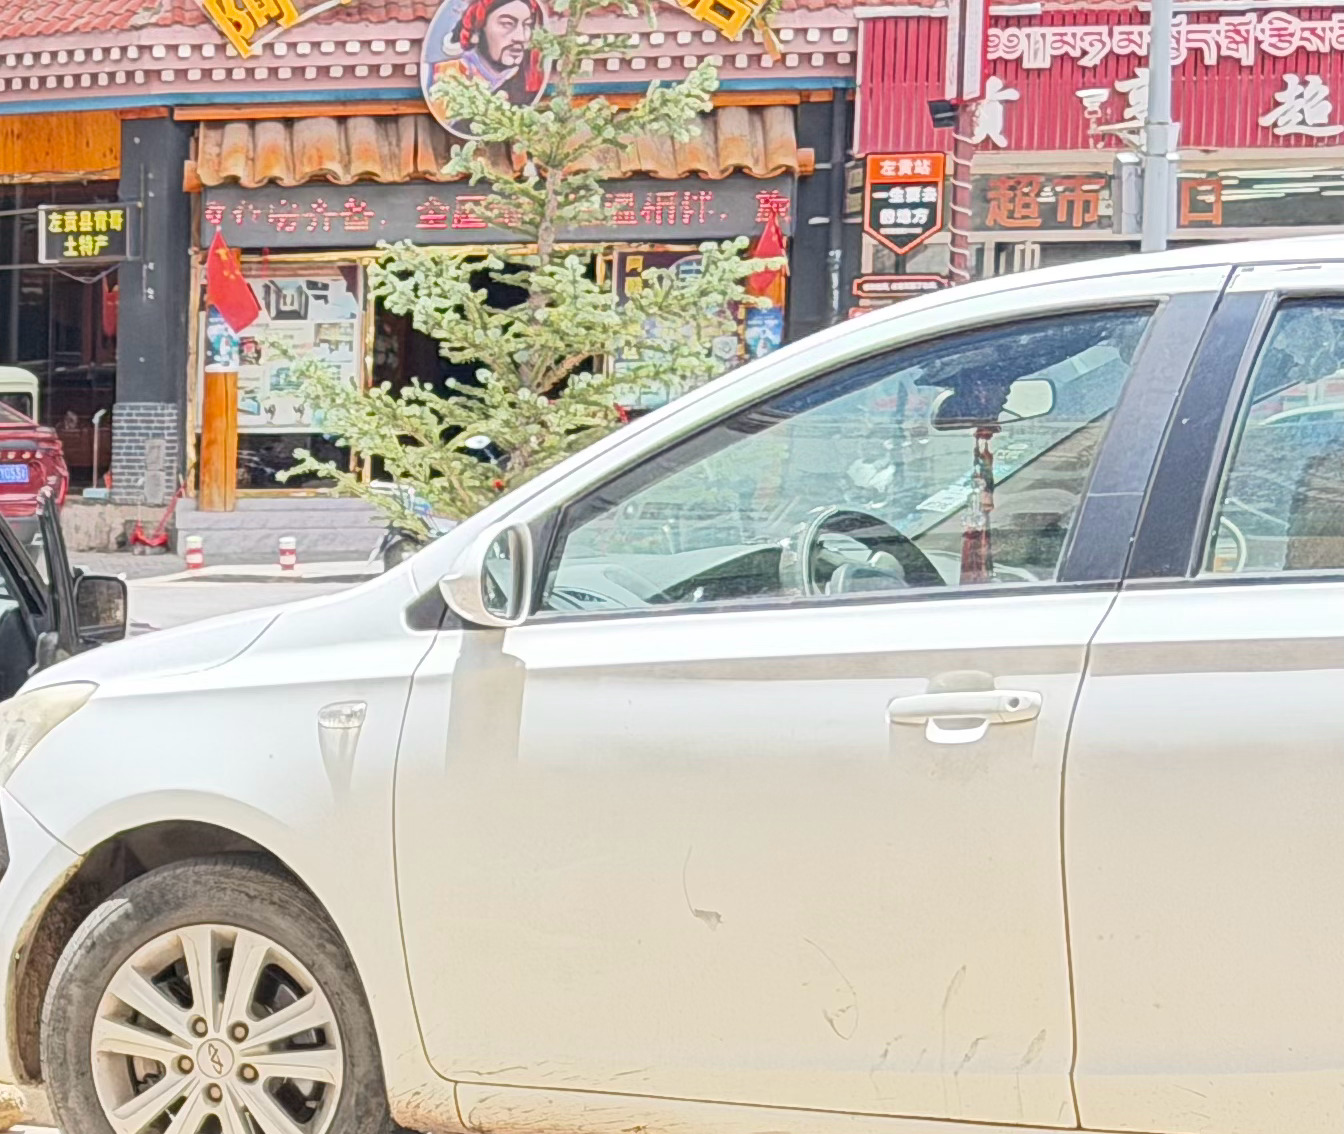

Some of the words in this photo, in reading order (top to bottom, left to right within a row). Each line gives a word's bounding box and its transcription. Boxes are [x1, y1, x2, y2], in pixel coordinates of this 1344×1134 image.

[986, 175, 1224, 229] 超市口
[62, 234, 109, 257] 土特产
